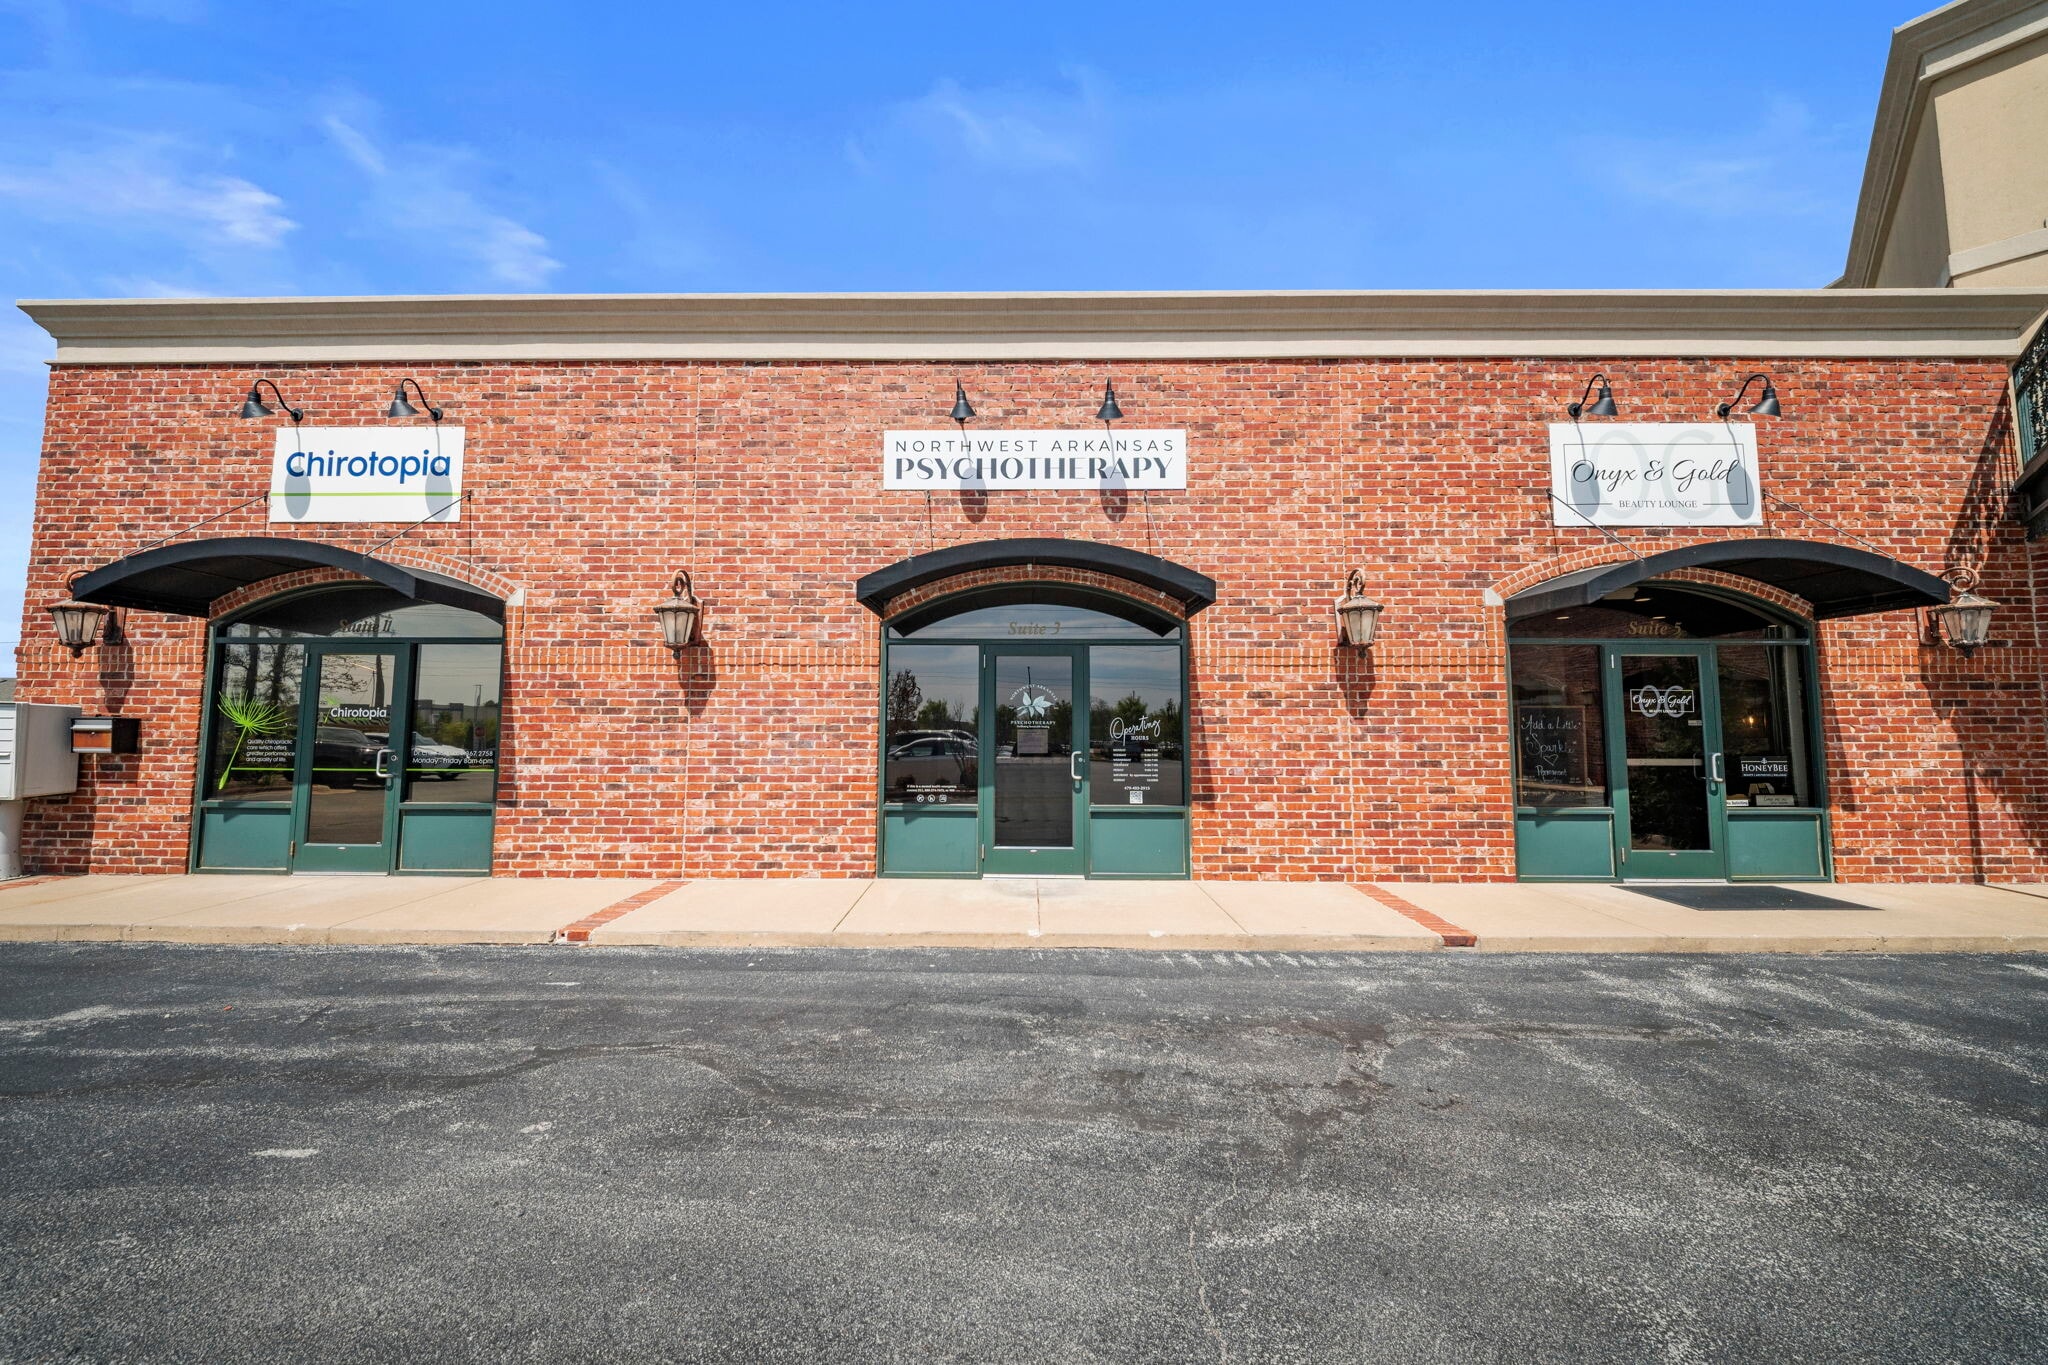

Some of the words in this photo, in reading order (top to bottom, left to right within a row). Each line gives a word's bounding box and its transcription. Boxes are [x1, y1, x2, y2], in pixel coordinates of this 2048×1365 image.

[895, 439, 1039, 453] NORTHWEST
[1051, 439, 1175, 452] ARKANSAS
[286, 449, 451, 484] Chirotopia
[895, 456, 1173, 480] PSYCHOTHERAPY
[1570, 459, 1638, 493] Onyx
[1643, 459, 1665, 482] &
[1672, 459, 1741, 493] Gold
[1619, 500, 1657, 509] BEAUTY
[1659, 500, 1698, 509] LOUNGE
[1008, 621, 1047, 635] Suite
[1628, 620, 1668, 635] Suite
[1632, 694, 1657, 708] Onyx
[1667, 694, 1692, 708] Gold
[330, 707, 387, 720] Chirotopia
[1110, 715, 1161, 747] Operating
[443, 757, 462, 765] Friday
